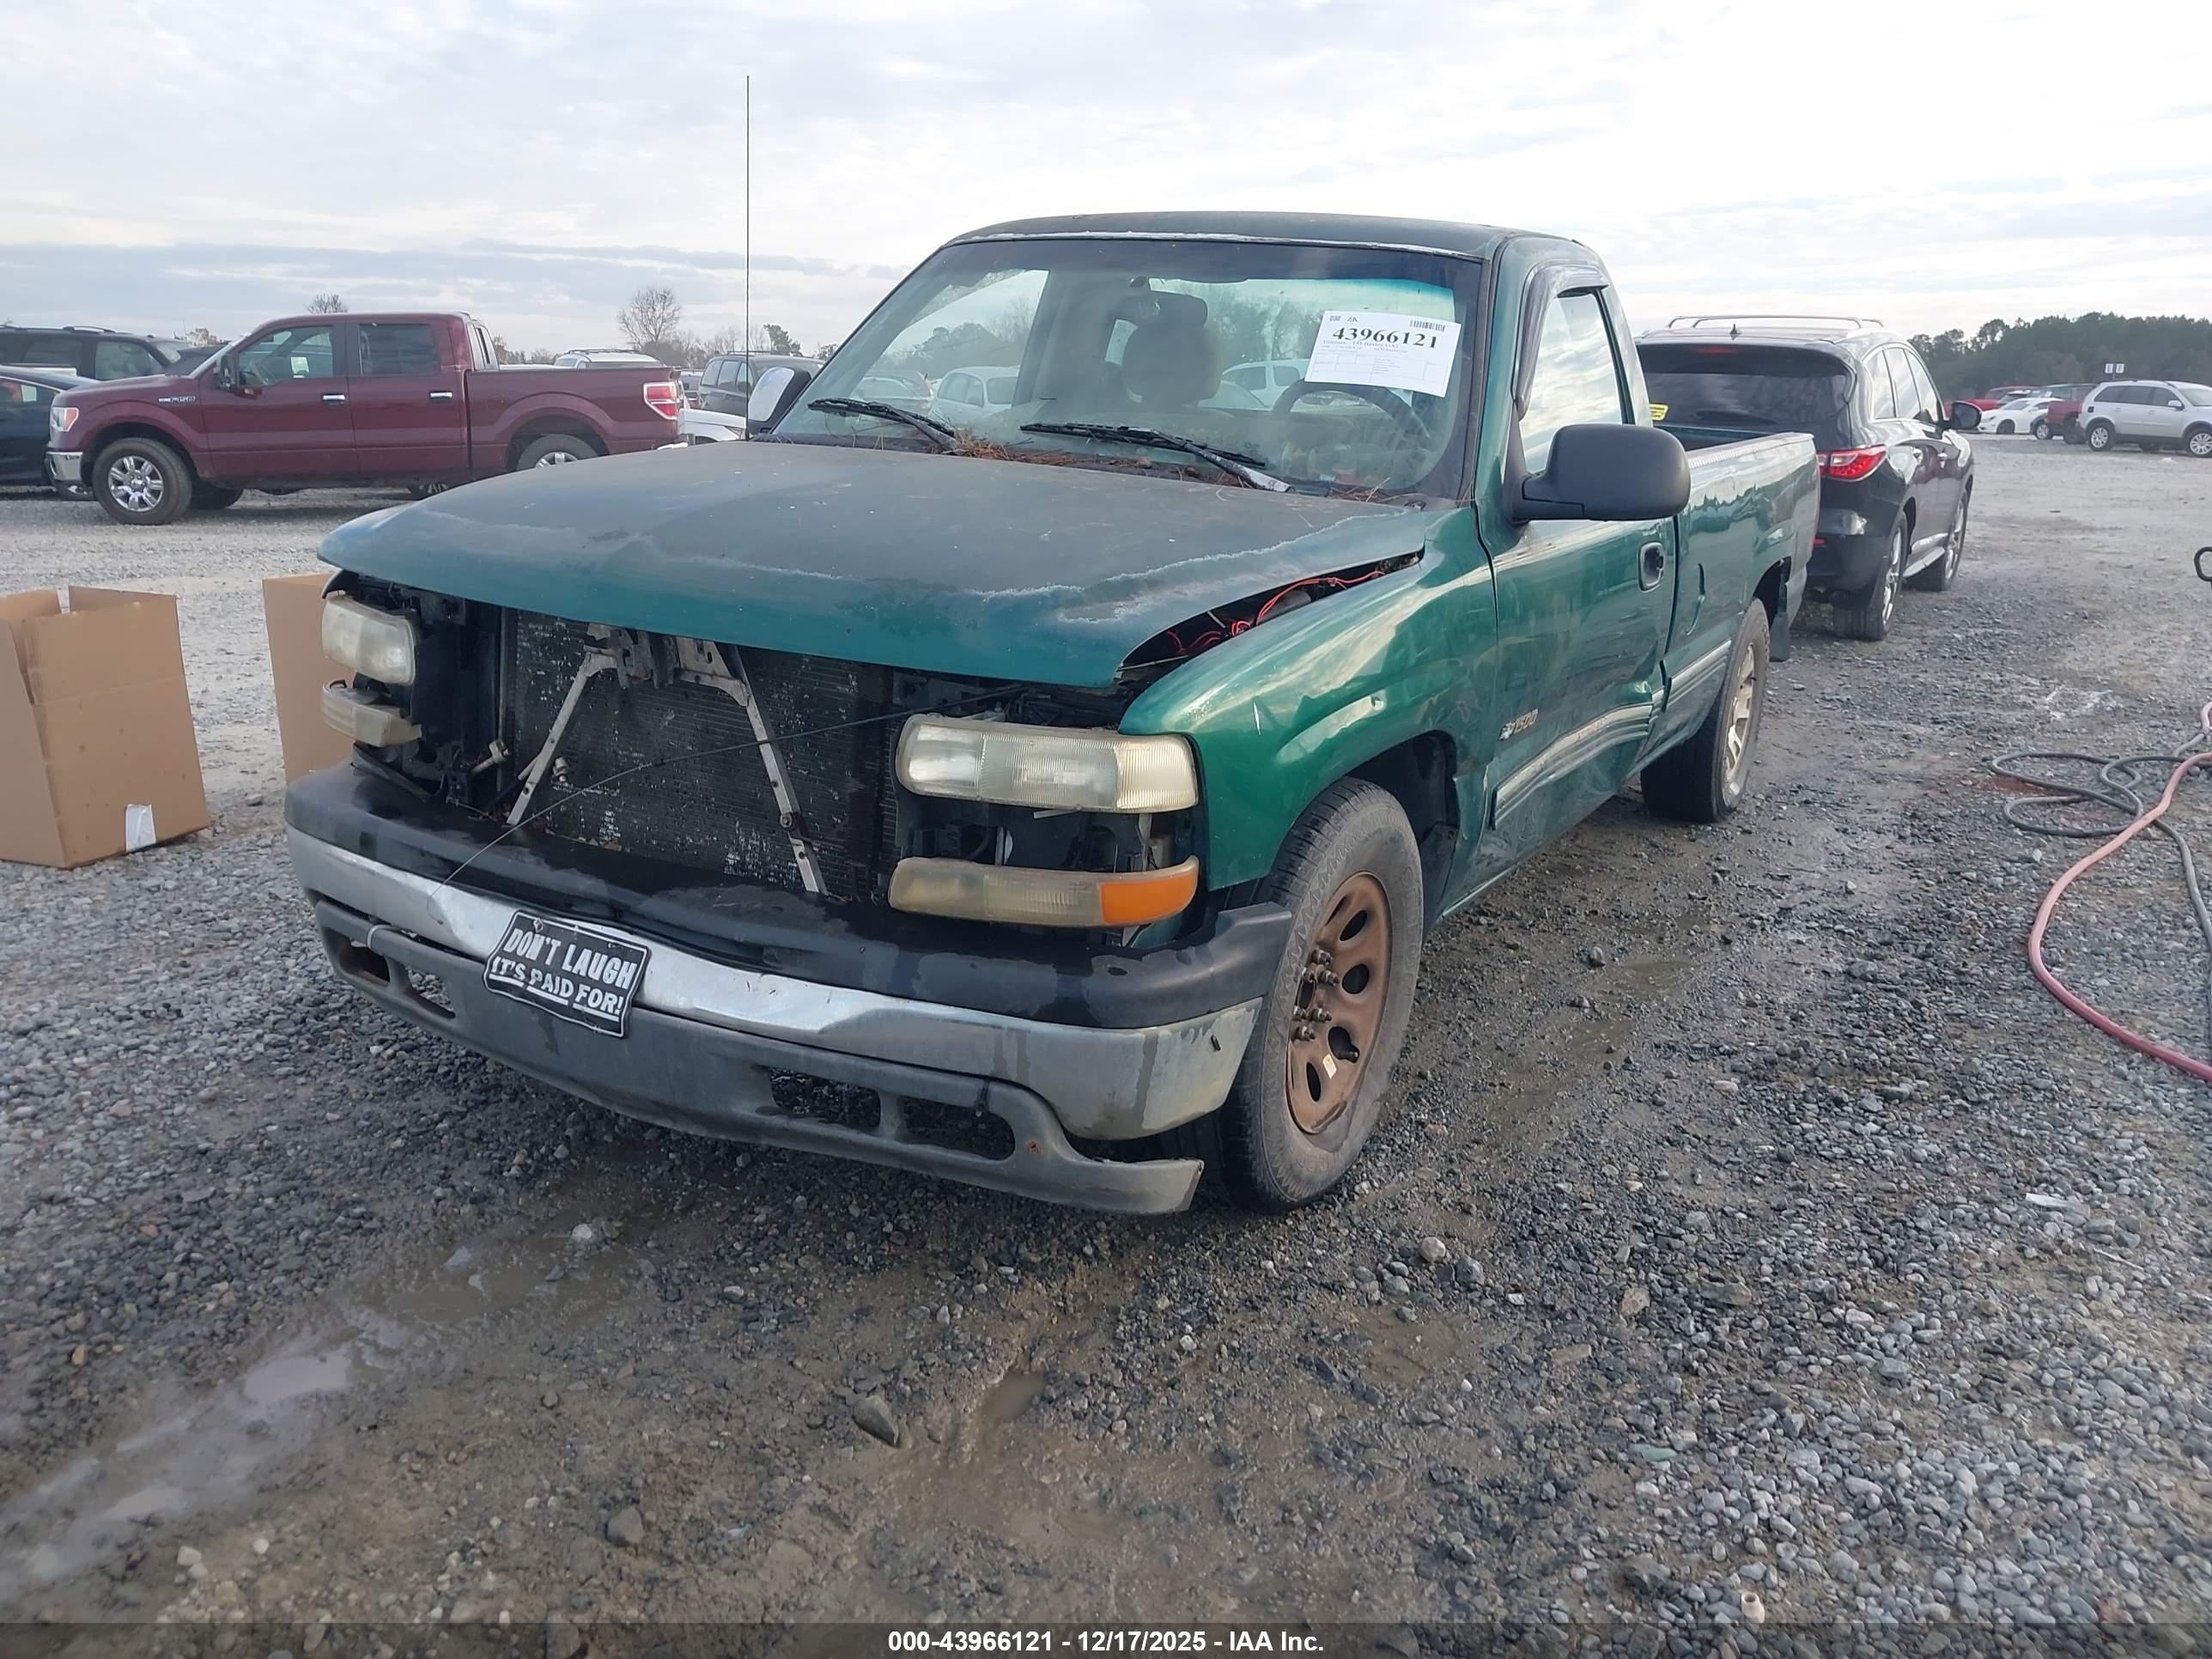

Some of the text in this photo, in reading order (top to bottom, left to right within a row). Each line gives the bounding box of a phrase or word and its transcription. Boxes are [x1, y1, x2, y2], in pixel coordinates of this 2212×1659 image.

[1333, 327, 1438, 349] 43966121
[491, 956, 624, 1016] IT'S PAID FOR!
[503, 927, 638, 989] DON'T LAUGH
